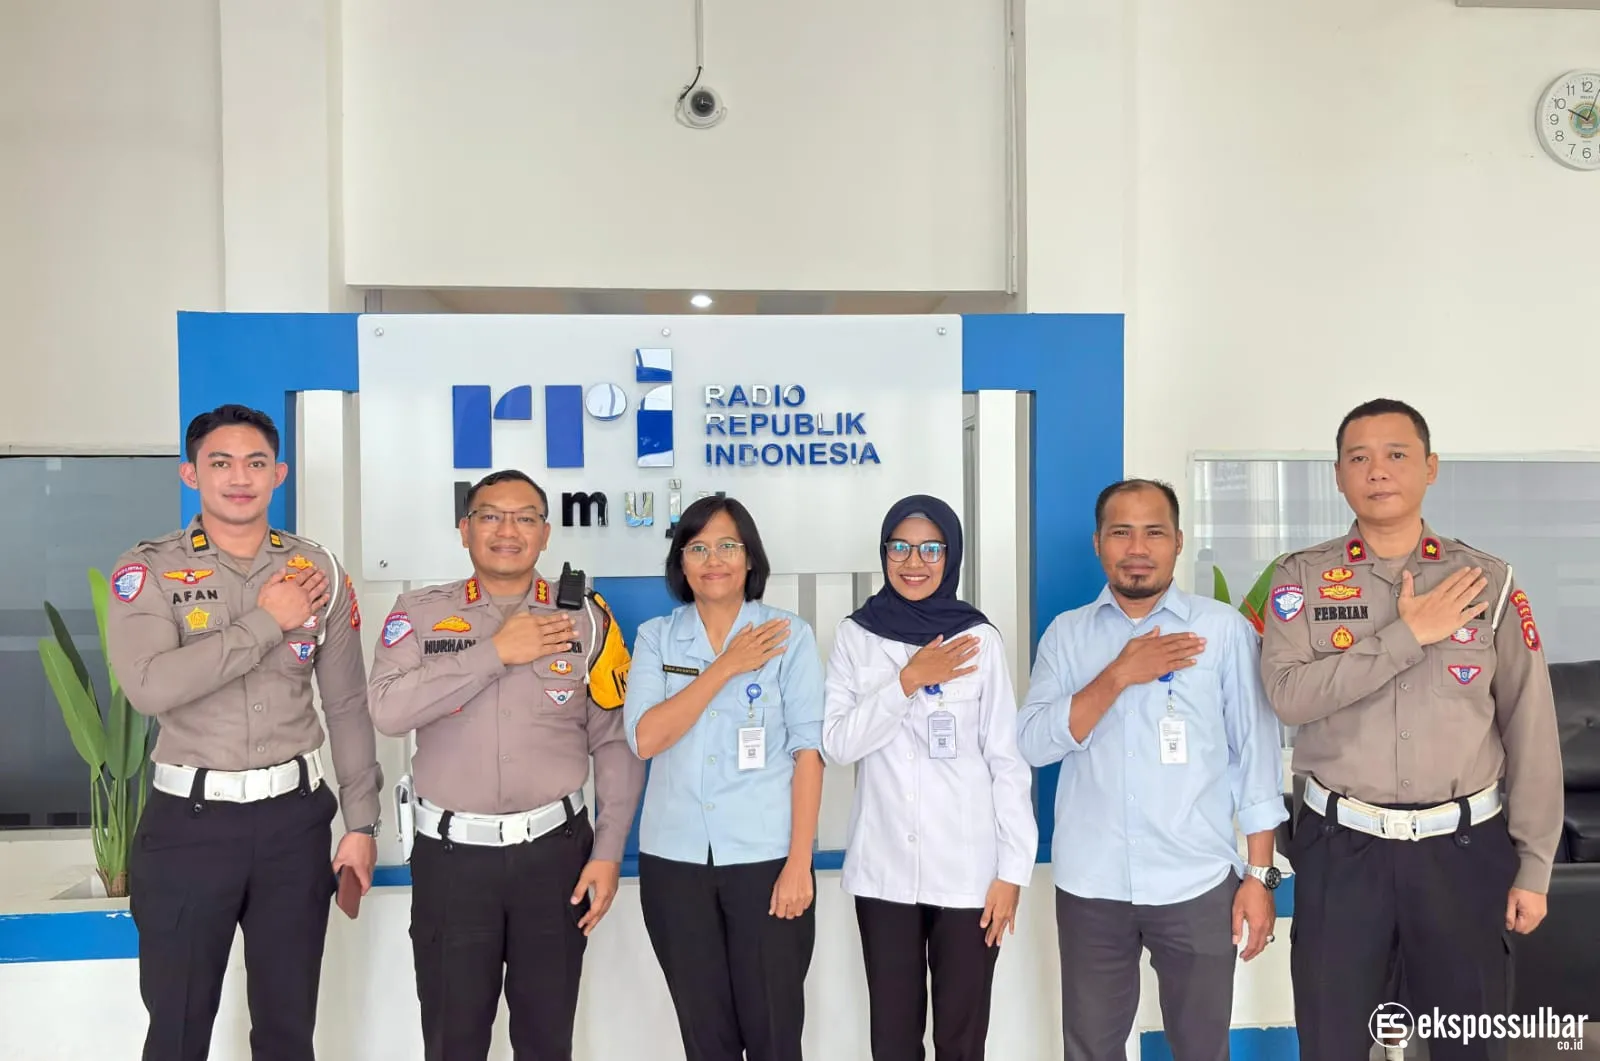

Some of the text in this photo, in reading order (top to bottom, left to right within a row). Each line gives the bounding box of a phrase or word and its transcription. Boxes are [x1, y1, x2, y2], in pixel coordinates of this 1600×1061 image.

[1566, 84, 1575, 96] 11
[1581, 81, 1593, 93] 12
[1553, 98, 1566, 110] 10
[1549, 114, 1559, 125] 9
[1555, 130, 1564, 142] 8
[1568, 144, 1576, 155] 7
[1582, 148, 1591, 159] 6
[704, 384, 806, 408] RADIO
[452, 348, 674, 469] rri
[704, 412, 867, 437] REPUBLIK
[704, 442, 881, 467] INDONESIA
[172, 589, 219, 605] AFAN
[1314, 605, 1369, 622] FEBRIAN
